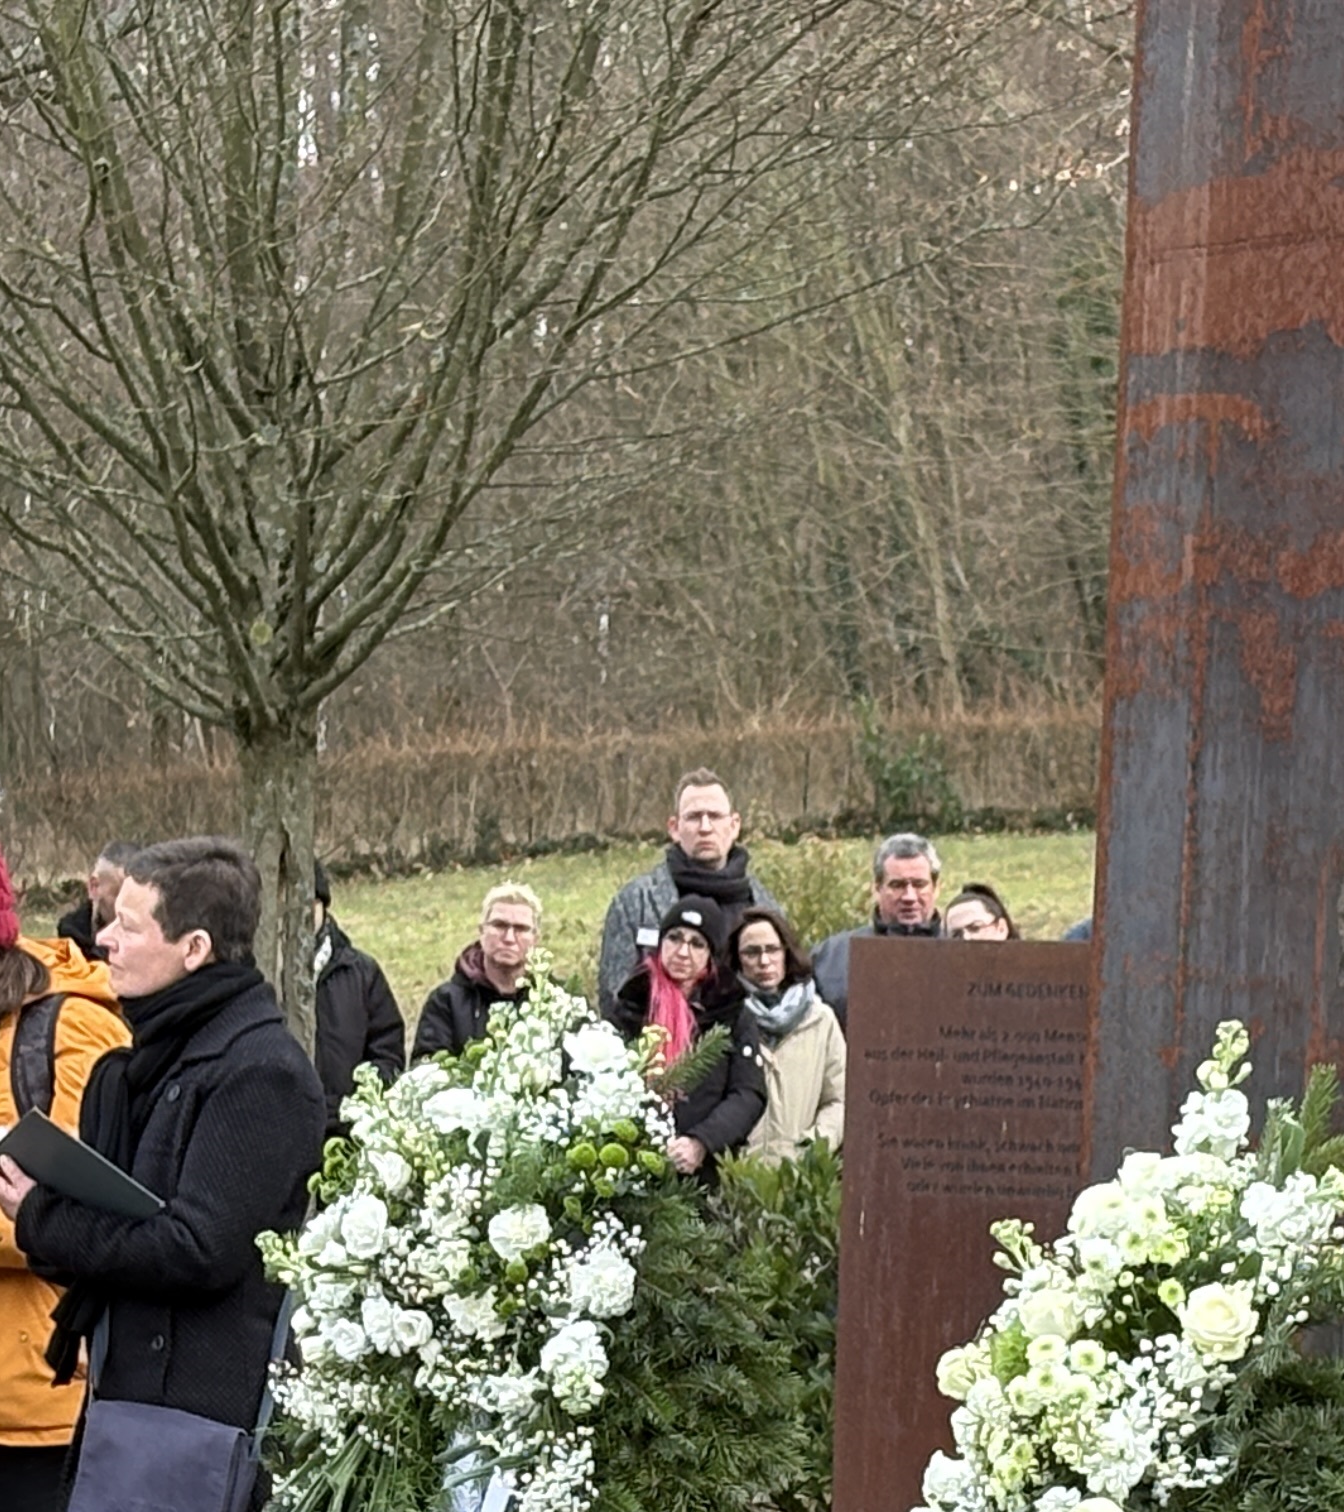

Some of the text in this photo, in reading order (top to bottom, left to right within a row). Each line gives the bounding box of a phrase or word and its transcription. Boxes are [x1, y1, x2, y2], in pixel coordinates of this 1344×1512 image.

[967, 981, 1089, 999] ZUM GEDENKEN
[939, 1024, 976, 1040] Mehr
[979, 1026, 998, 1042] als
[864, 1049, 888, 1062] aus
[891, 1046, 914, 1061] der
[953, 1049, 980, 1063] und
[962, 1073, 1014, 1087] wurden
[869, 1088, 909, 1106] Opfer
[902, 1137, 944, 1150] waren
[902, 1157, 935, 1171] Viele
